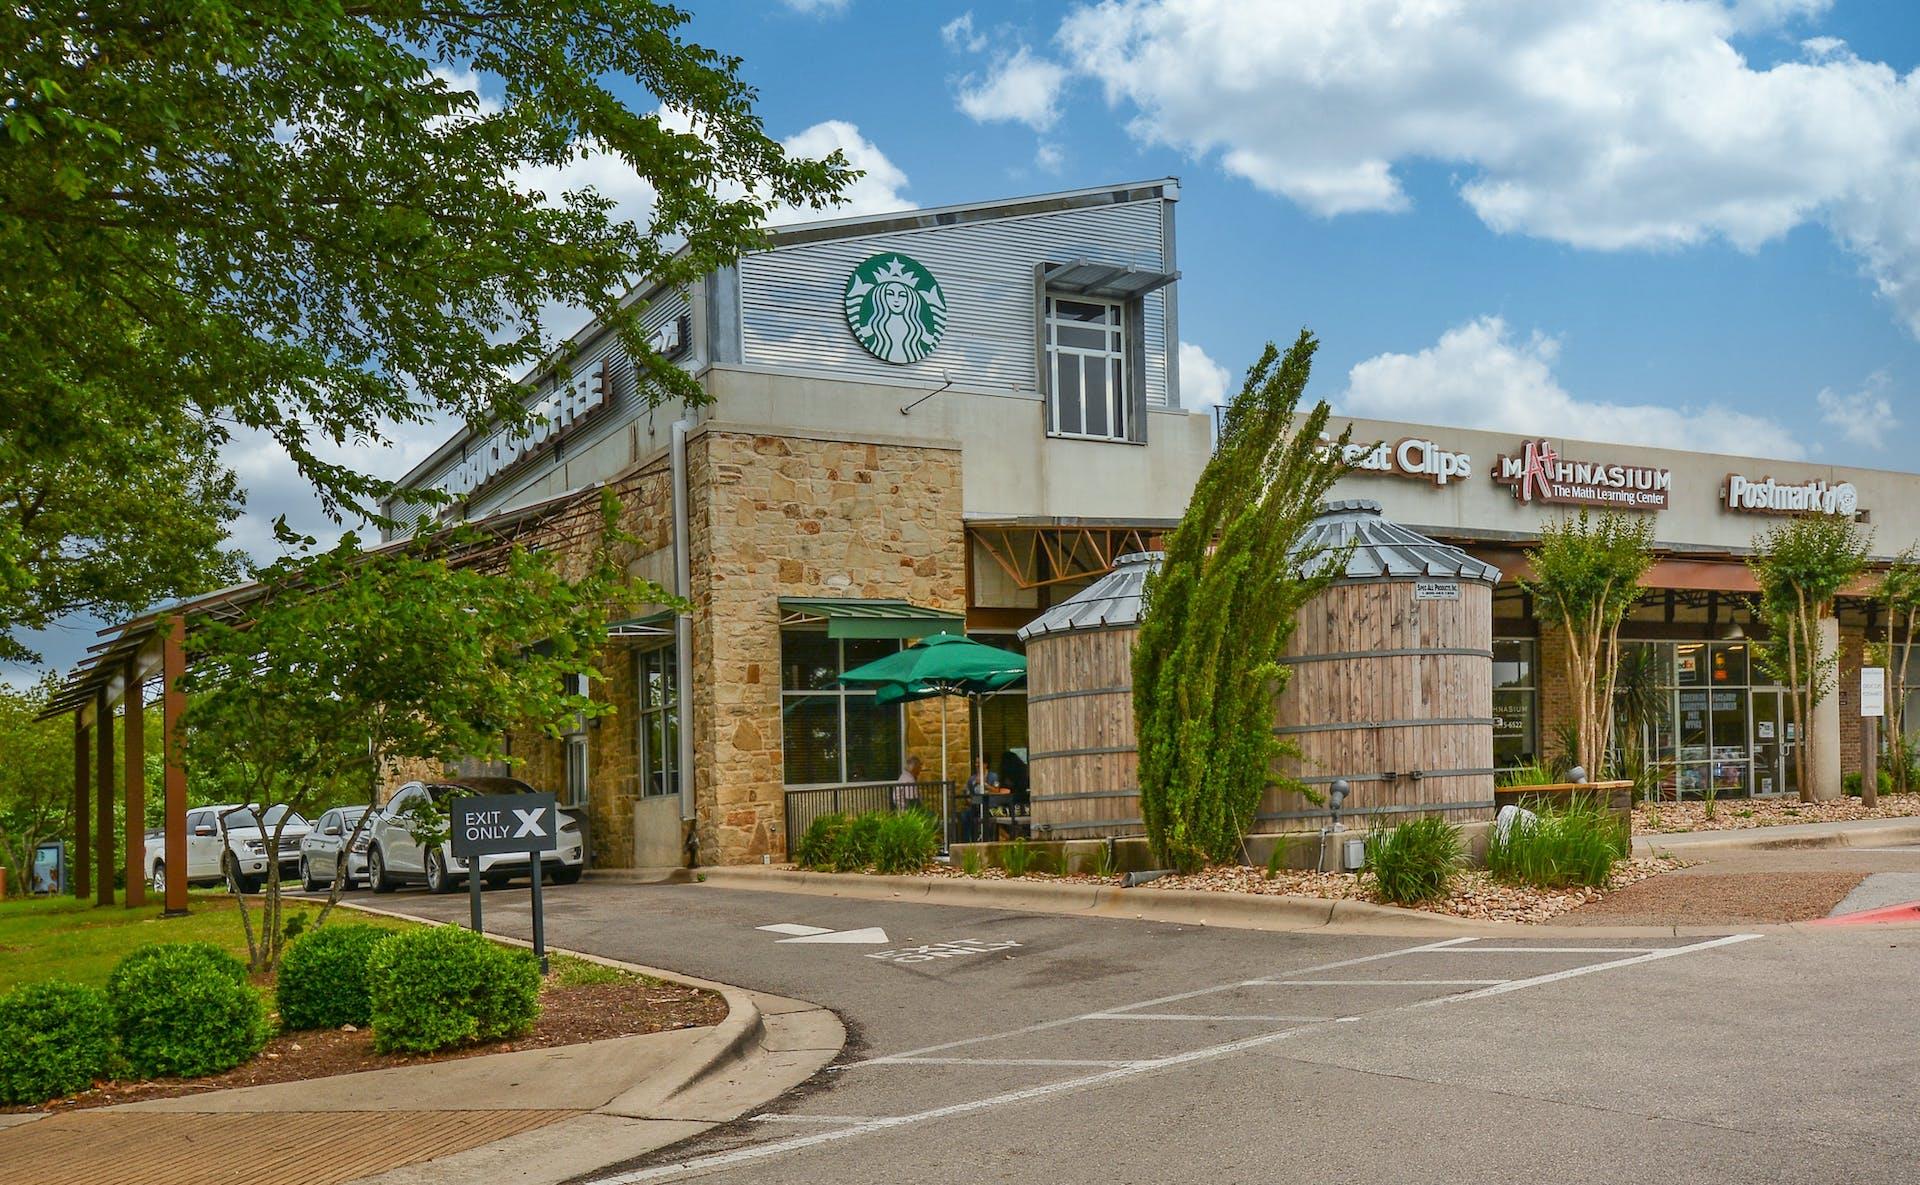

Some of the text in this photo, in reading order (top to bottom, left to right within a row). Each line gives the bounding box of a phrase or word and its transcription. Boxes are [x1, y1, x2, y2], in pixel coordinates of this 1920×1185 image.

[522, 361, 604, 451] COFFEE
[1397, 439, 1472, 485] Clips
[1552, 484, 1665, 505] The Math Learning Center
[1729, 475, 1838, 515] Postmark'd
[465, 811, 501, 826] EXIT
[466, 825, 510, 840] ONLY
